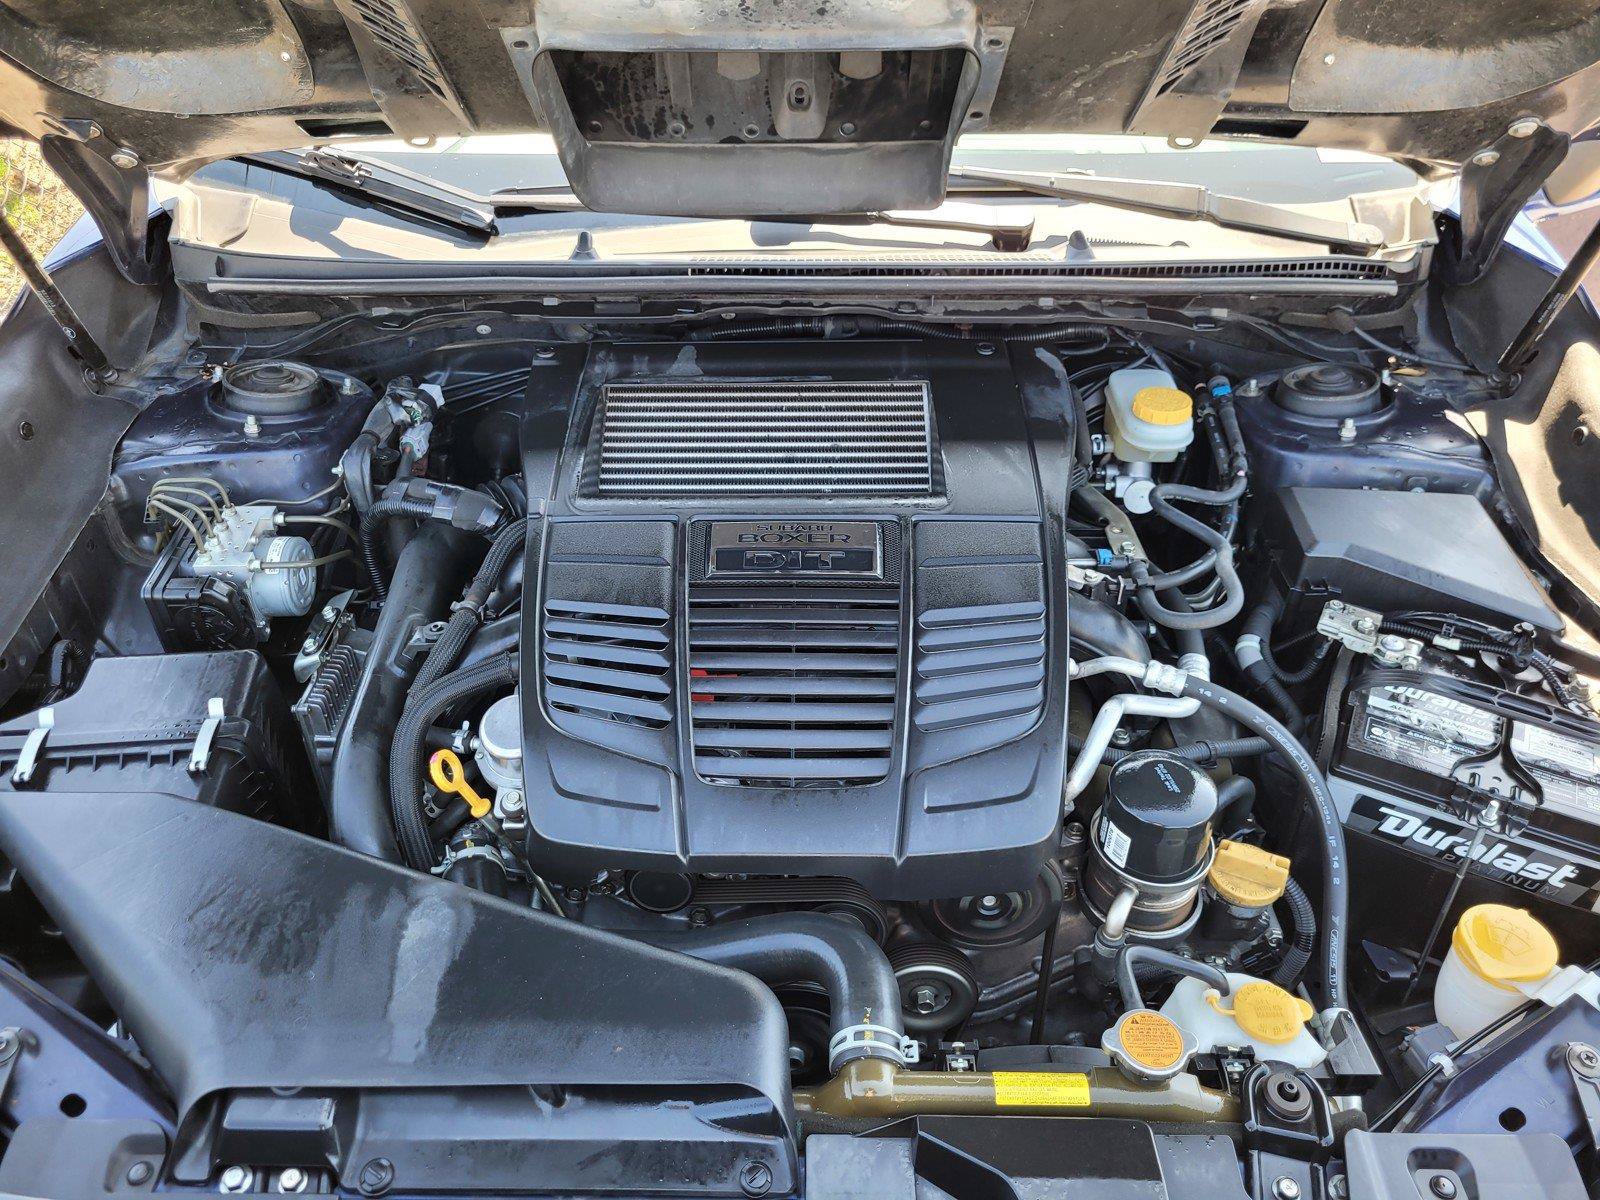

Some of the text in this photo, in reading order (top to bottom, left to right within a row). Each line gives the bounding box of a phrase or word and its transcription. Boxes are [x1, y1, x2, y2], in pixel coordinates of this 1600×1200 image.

[737, 532, 853, 544] BOXER
[756, 524, 833, 532] SUBARU
[743, 550, 846, 570] DIT
[1378, 806, 1579, 889] Duralast
[1441, 853, 1560, 897] PLATINUM
